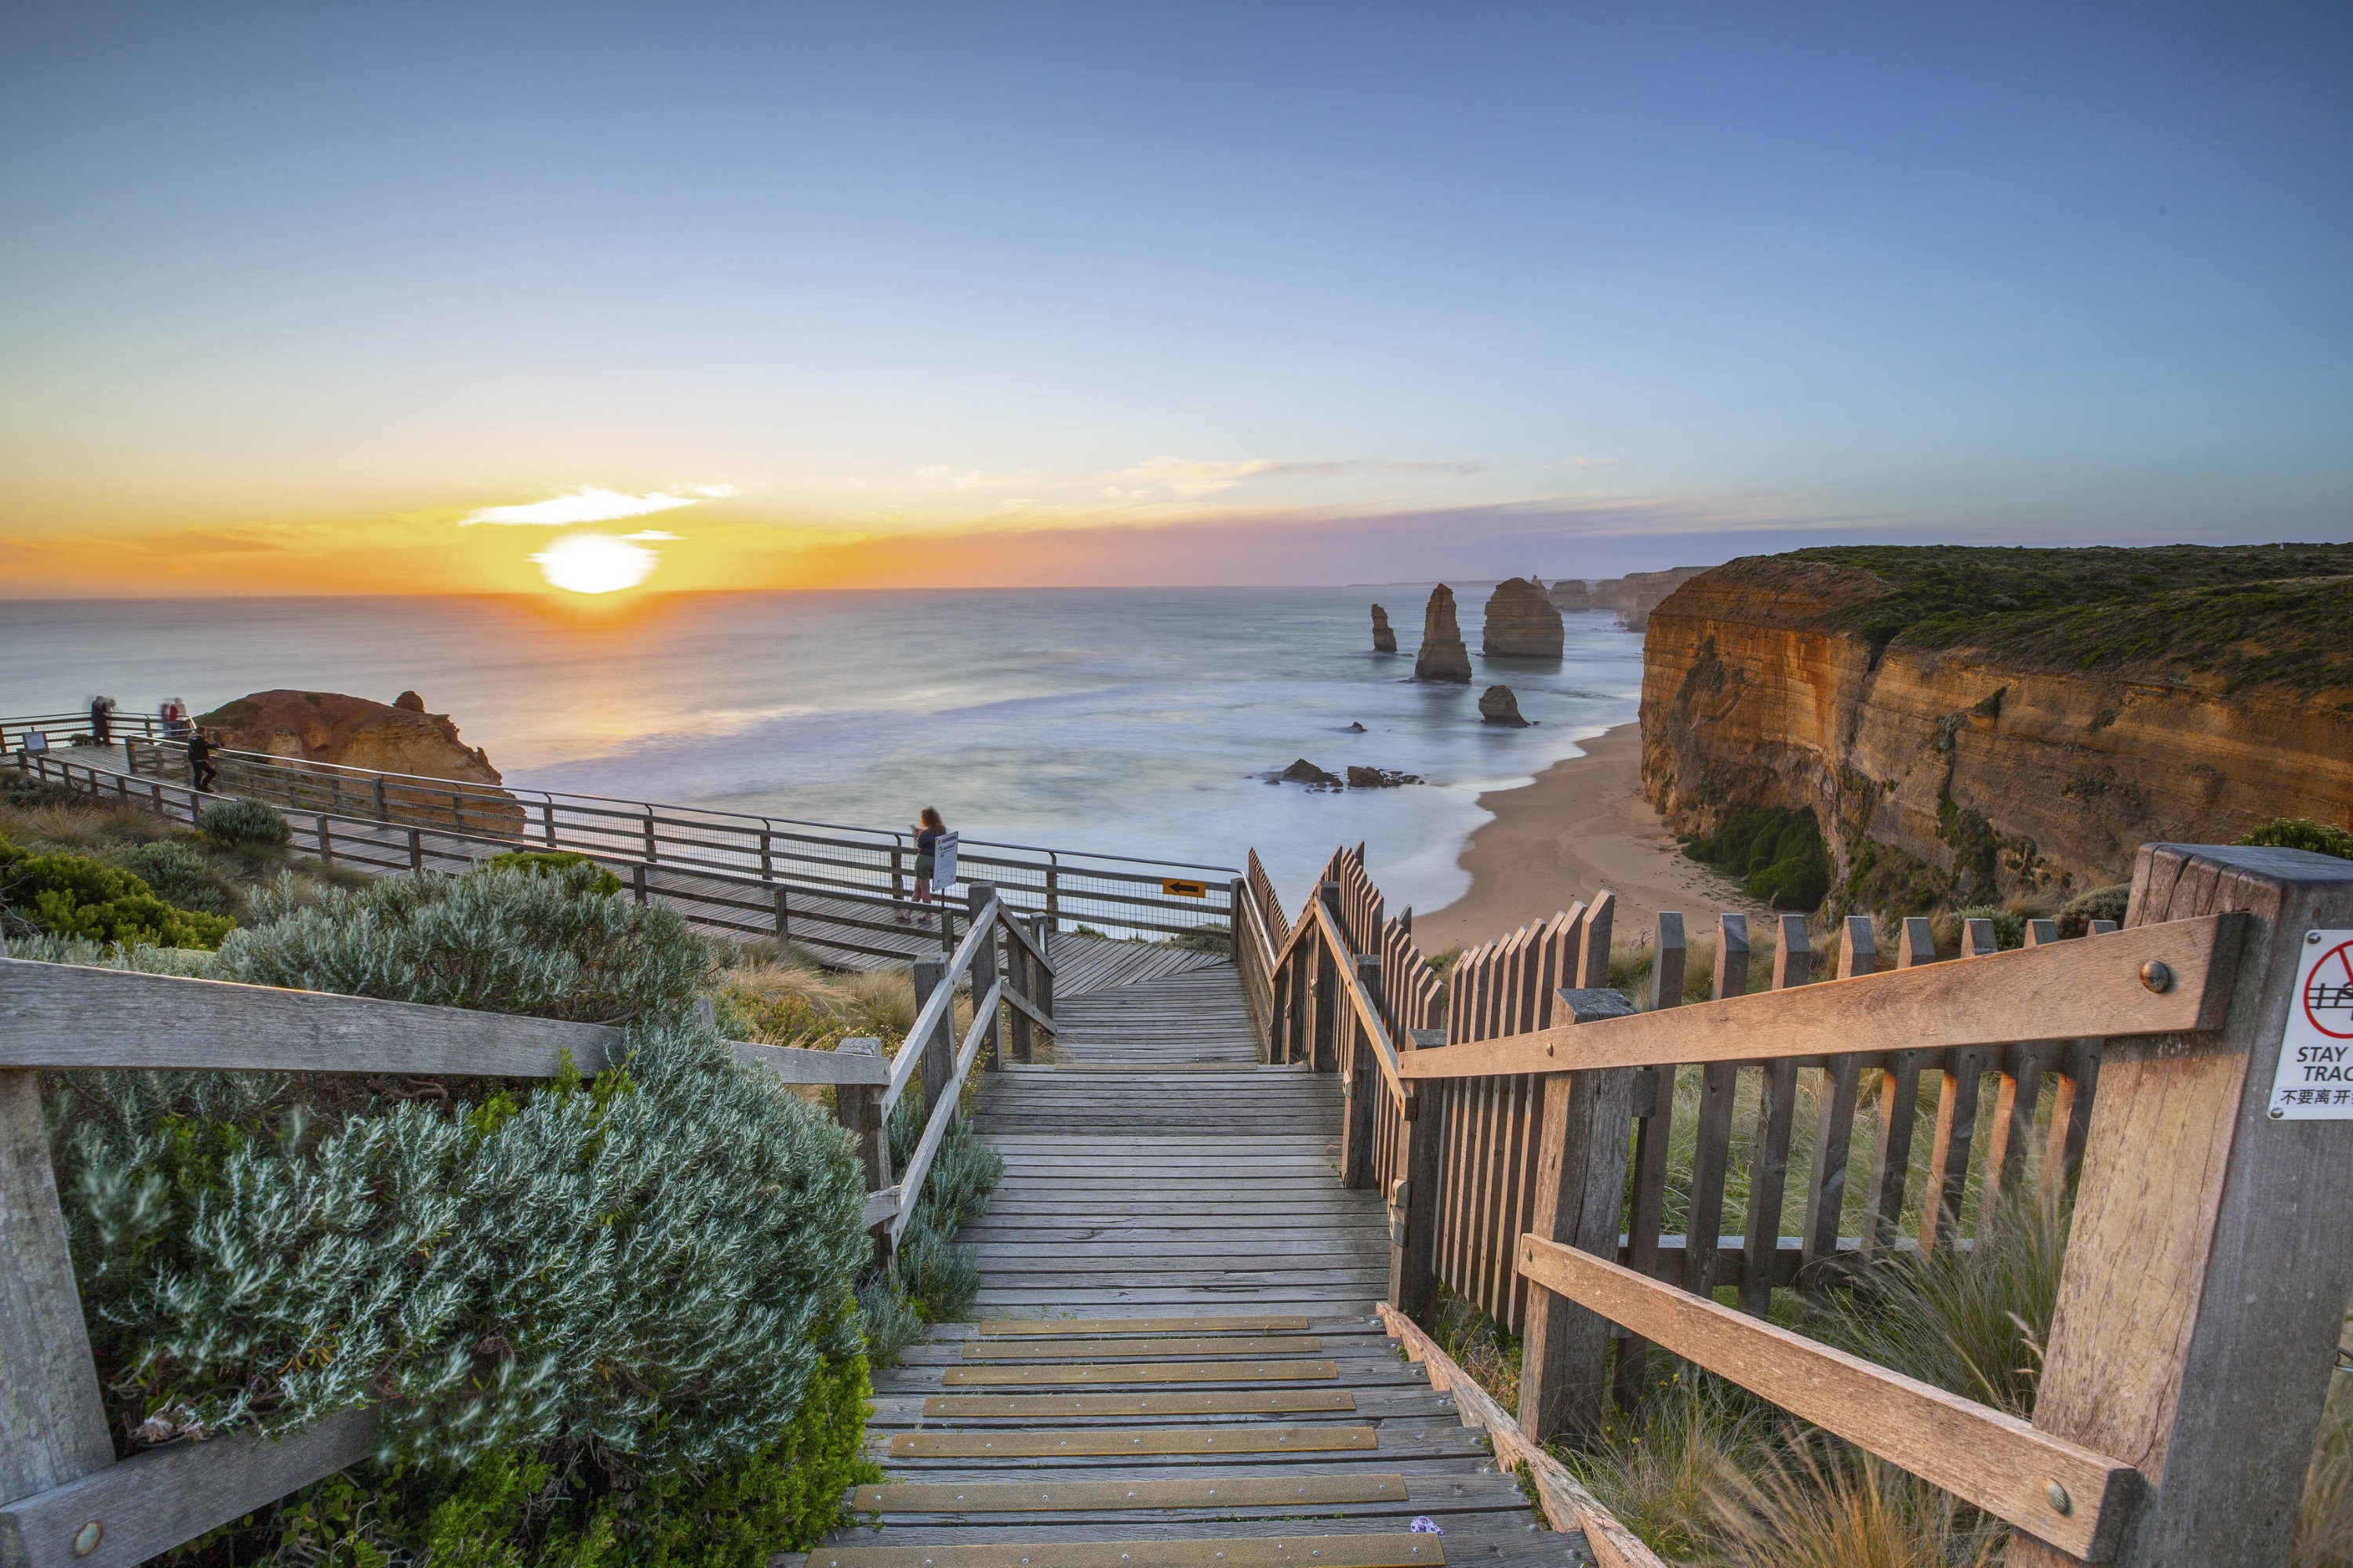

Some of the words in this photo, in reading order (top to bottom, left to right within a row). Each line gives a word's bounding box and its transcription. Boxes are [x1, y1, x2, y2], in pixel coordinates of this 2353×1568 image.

[2297, 1046, 2349, 1062] STAY
[2280, 1089, 2353, 1104] 不要离开
